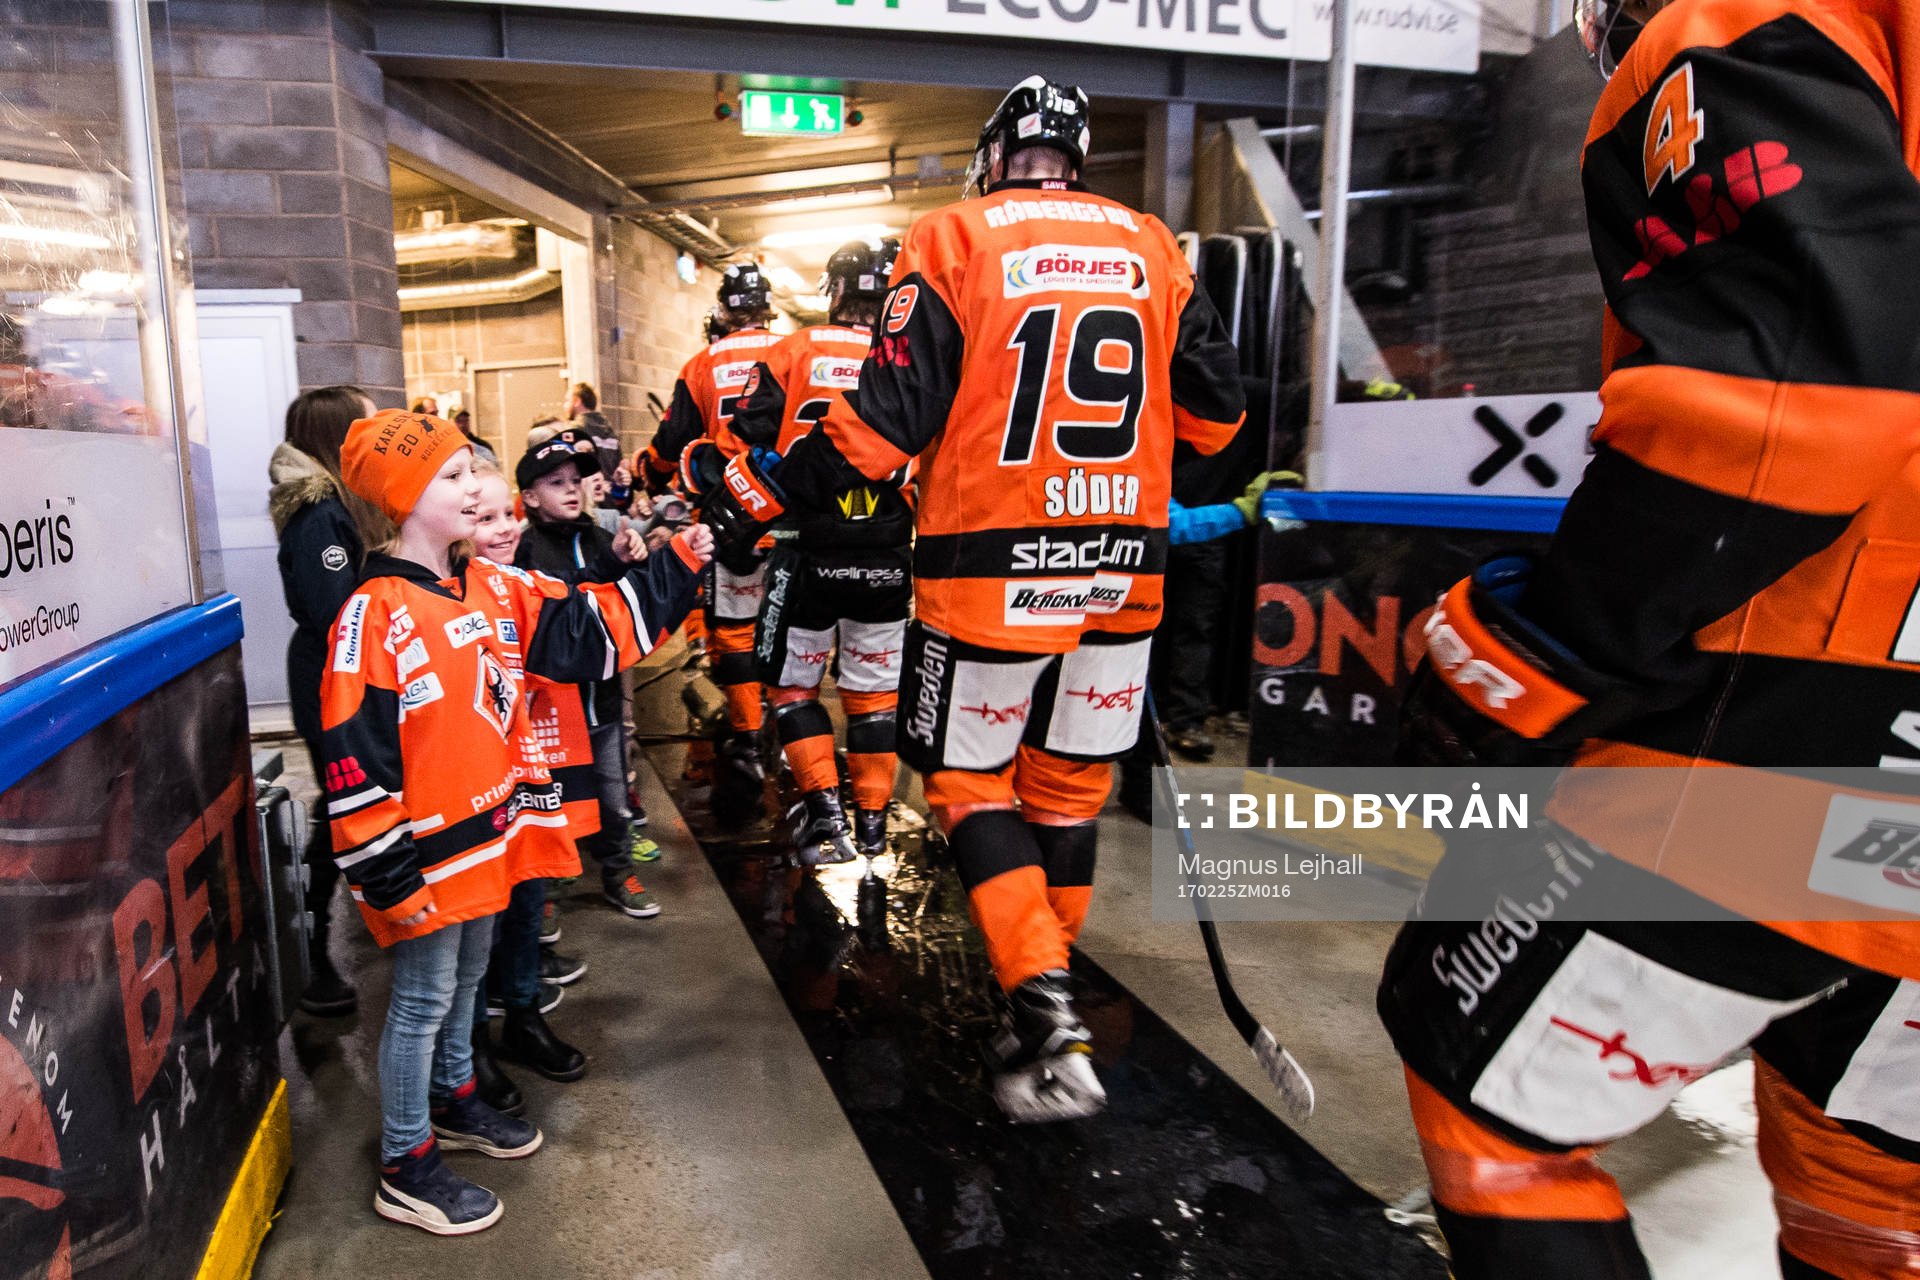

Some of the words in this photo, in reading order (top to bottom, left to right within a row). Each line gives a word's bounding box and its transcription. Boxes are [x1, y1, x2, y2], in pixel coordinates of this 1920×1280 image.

[946, 0, 1288, 40] -MEC
[1312, 2, 1458, 34] ww.rudvi.se
[1643, 60, 1705, 198] 4
[1035, 252, 1127, 275] BÖRJES
[998, 303, 1147, 466] 19
[397, 433, 419, 457] 20
[1044, 467, 1140, 518] SÖDER
[817, 566, 904, 580] wellness
[906, 639, 949, 748] Sweden
